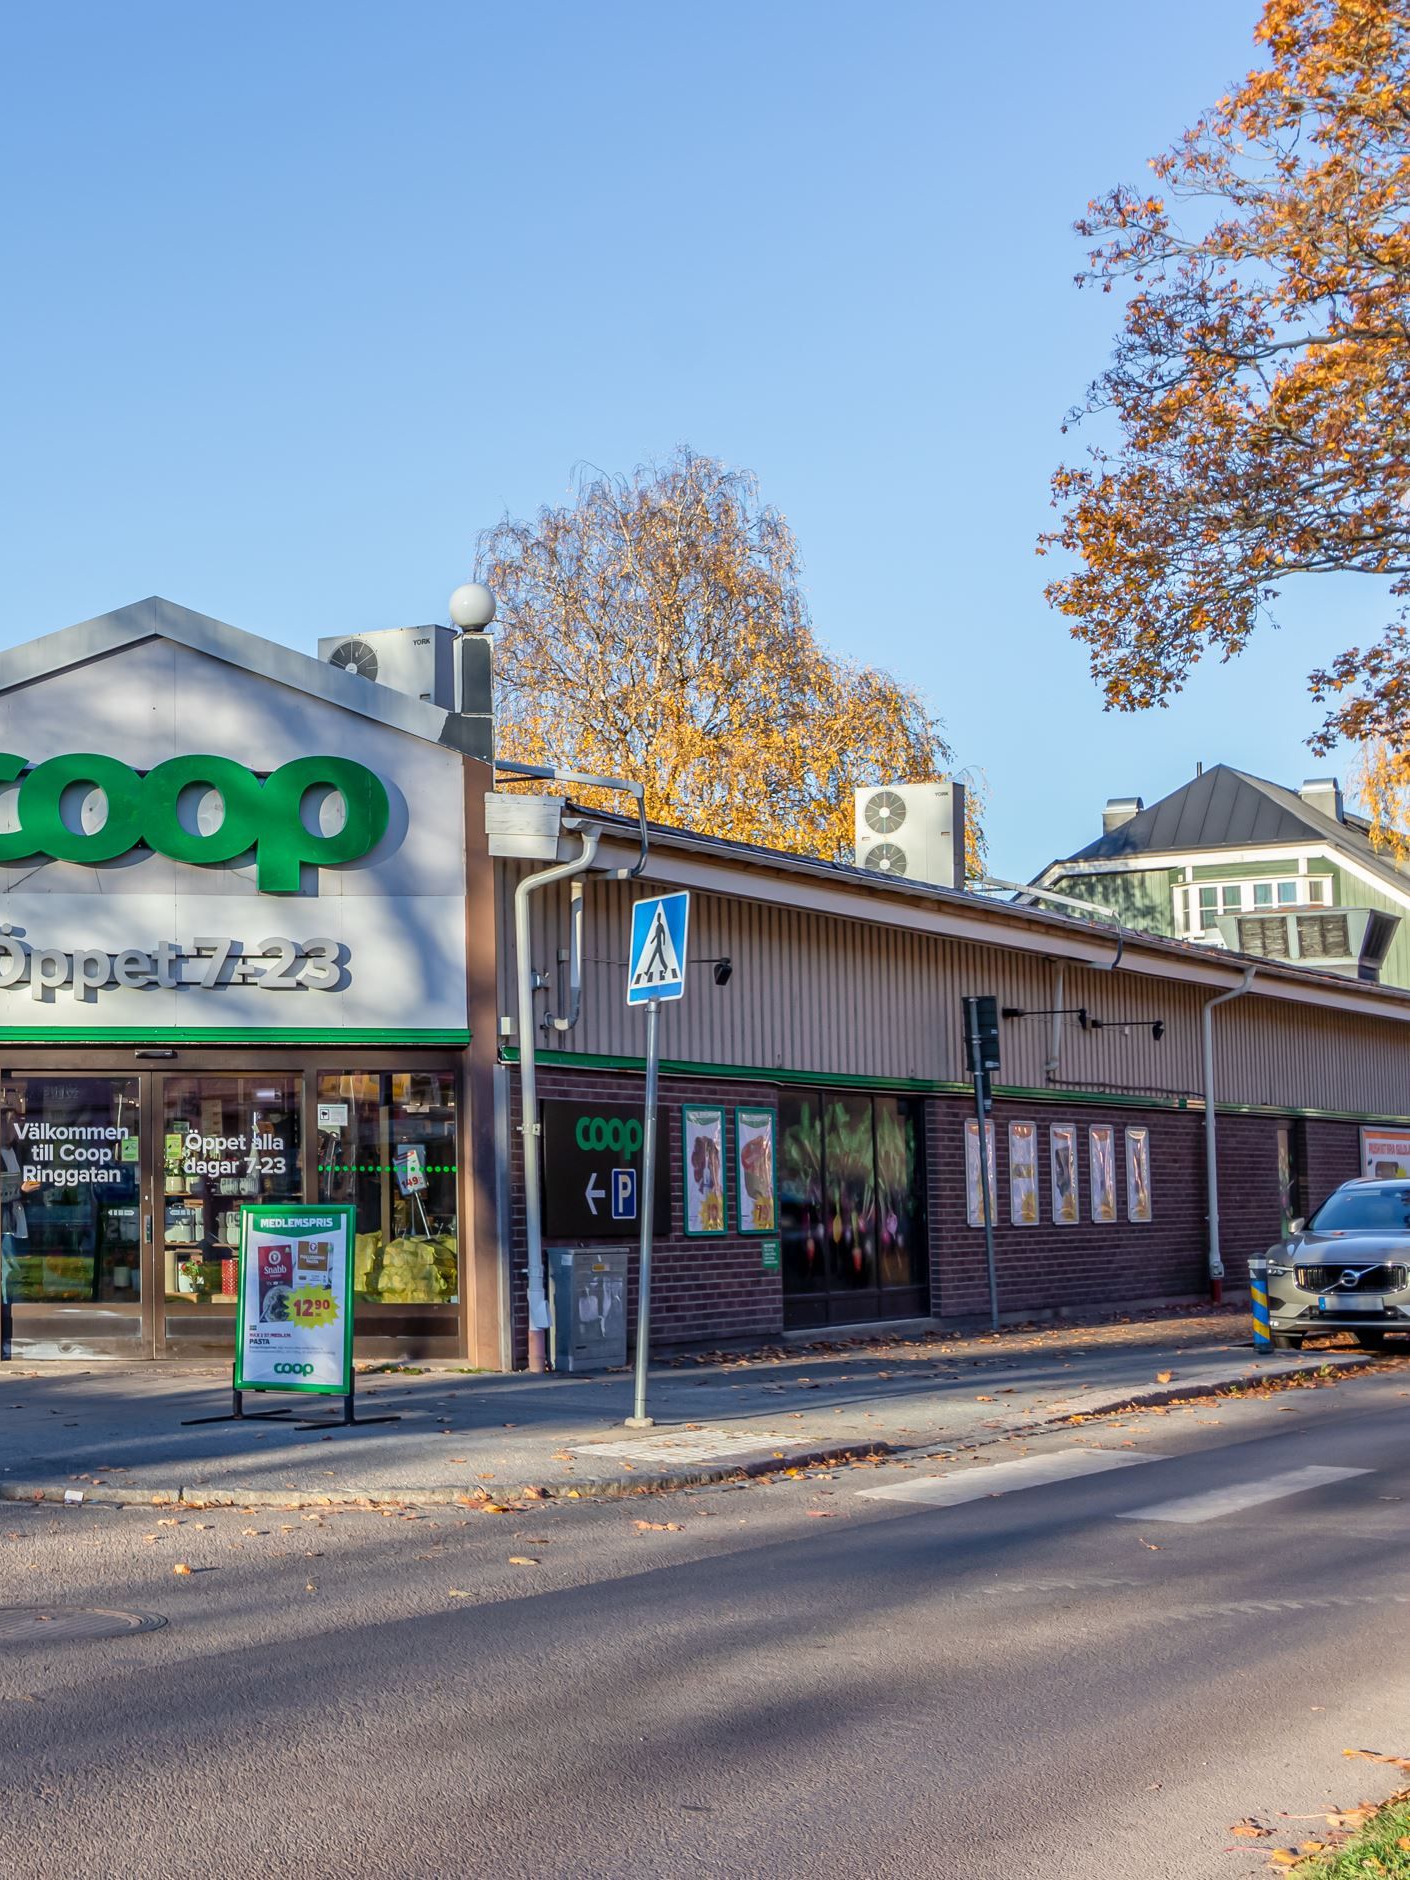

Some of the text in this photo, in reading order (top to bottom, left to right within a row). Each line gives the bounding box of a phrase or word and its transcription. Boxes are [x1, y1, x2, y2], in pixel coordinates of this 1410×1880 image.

[193, 937, 342, 990] 7-23
[13, 1123, 129, 1140] Välkommen
[185, 1129, 284, 1154] Öppet alla
[575, 1117, 643, 1160] coop
[31, 1144, 112, 1165] till Coop
[23, 1165, 121, 1187] Ringgatan
[183, 1157, 286, 1178] dagar 7-23
[618, 1174, 632, 1213] P
[260, 1218, 333, 1228] MEDLEMSPRIS
[264, 1264, 287, 1274] Snabb
[274, 1362, 314, 1377] coop
